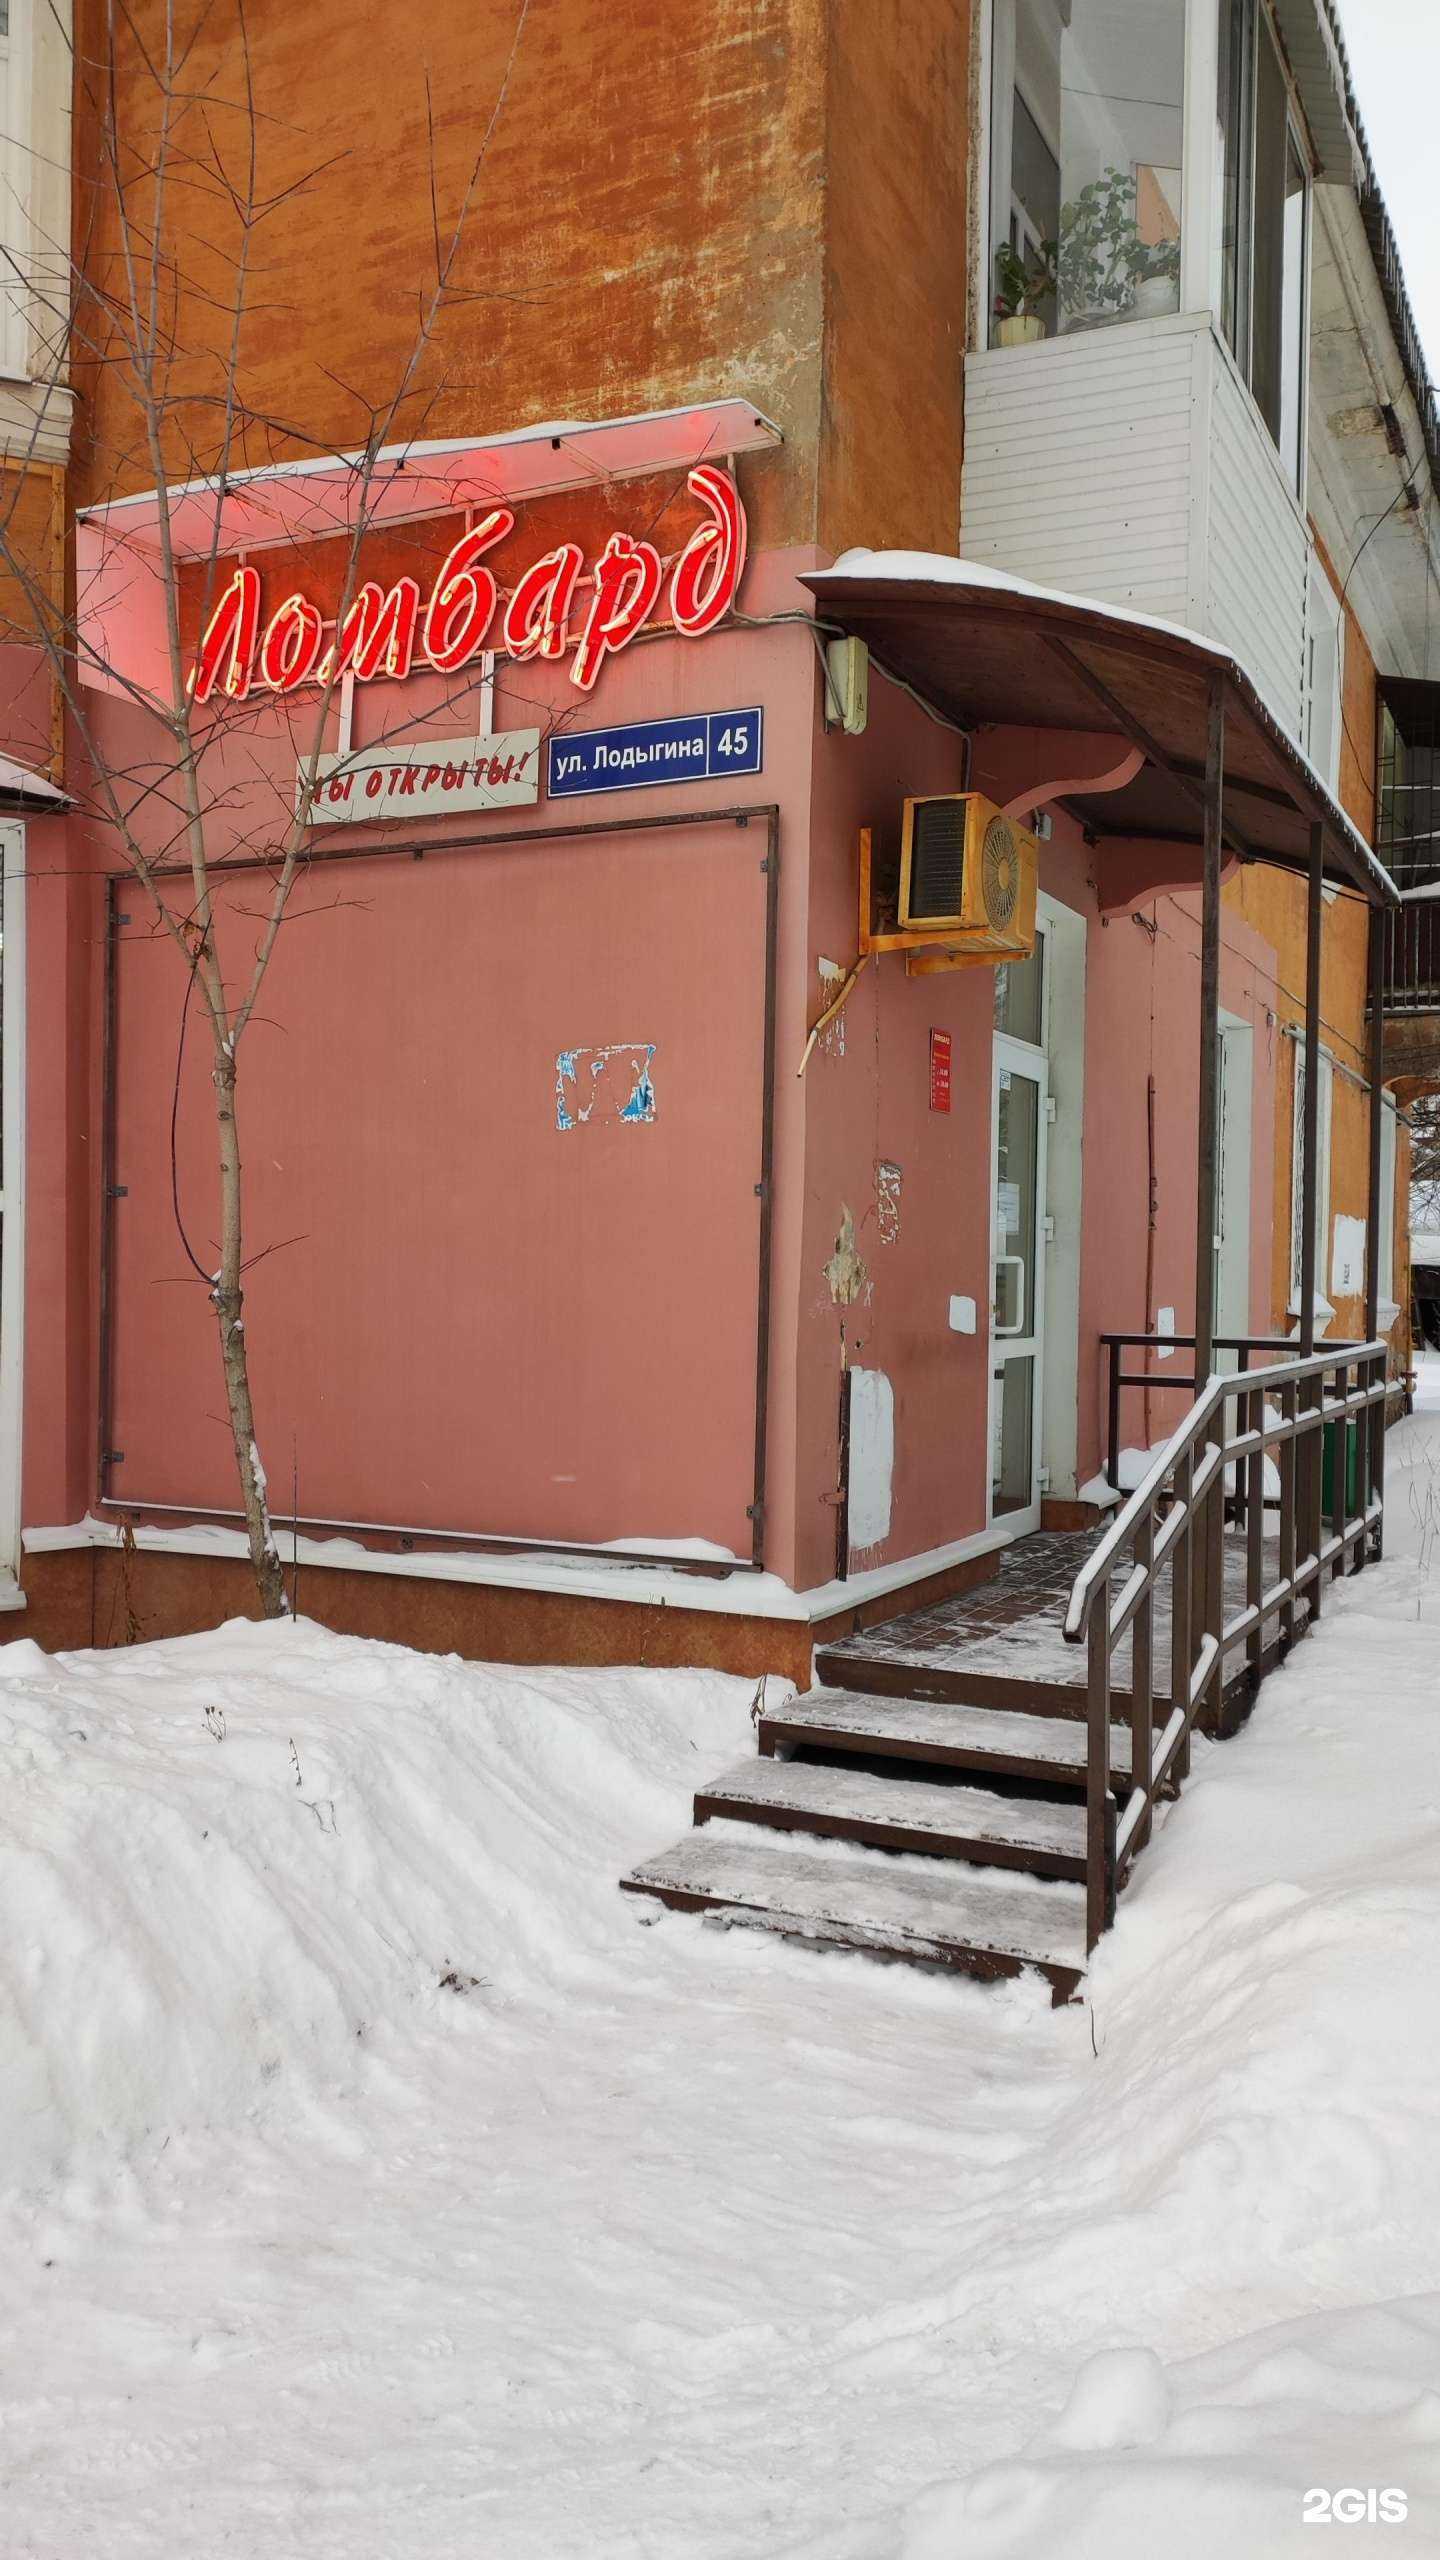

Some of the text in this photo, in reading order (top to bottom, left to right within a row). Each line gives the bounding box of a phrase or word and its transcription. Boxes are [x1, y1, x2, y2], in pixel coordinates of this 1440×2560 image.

[186, 465, 746, 703] Ломбард
[365, 751, 531, 798] ОТКРЫТЫ!
[556, 726, 749, 780] ул. Лодыгина 45
